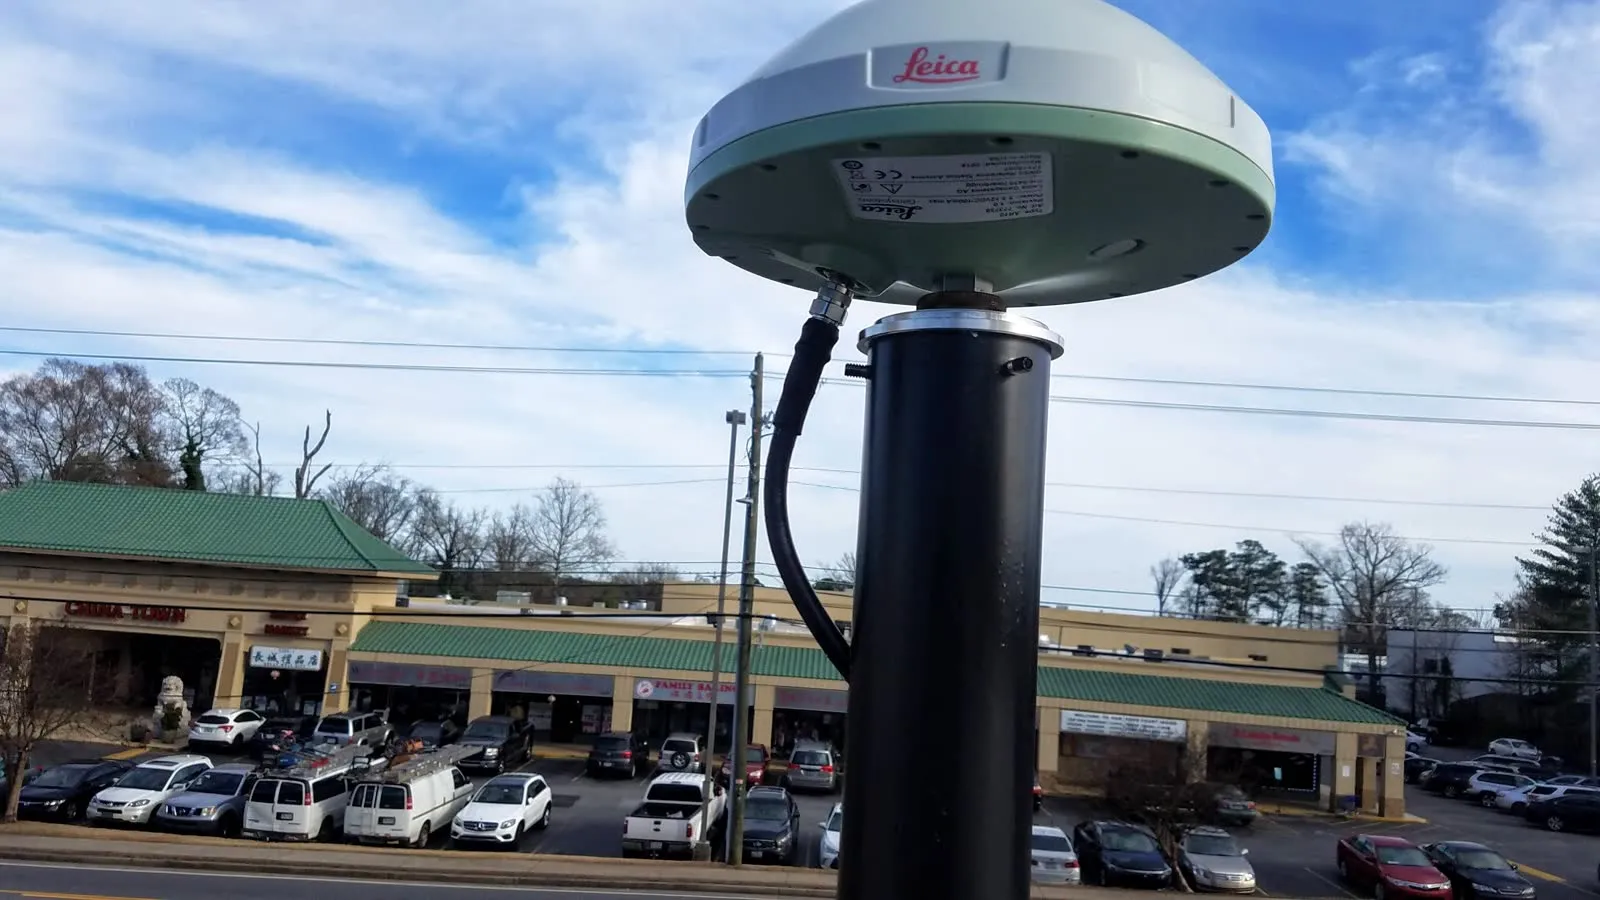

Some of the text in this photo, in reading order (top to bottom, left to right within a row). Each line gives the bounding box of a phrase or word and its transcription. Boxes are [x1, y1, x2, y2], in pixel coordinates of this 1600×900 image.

[893, 46, 981, 84] Leica
[858, 204, 923, 221] Leica
[64, 601, 186, 622] CHINA TOWN
[654, 680, 693, 691] FAMILY
